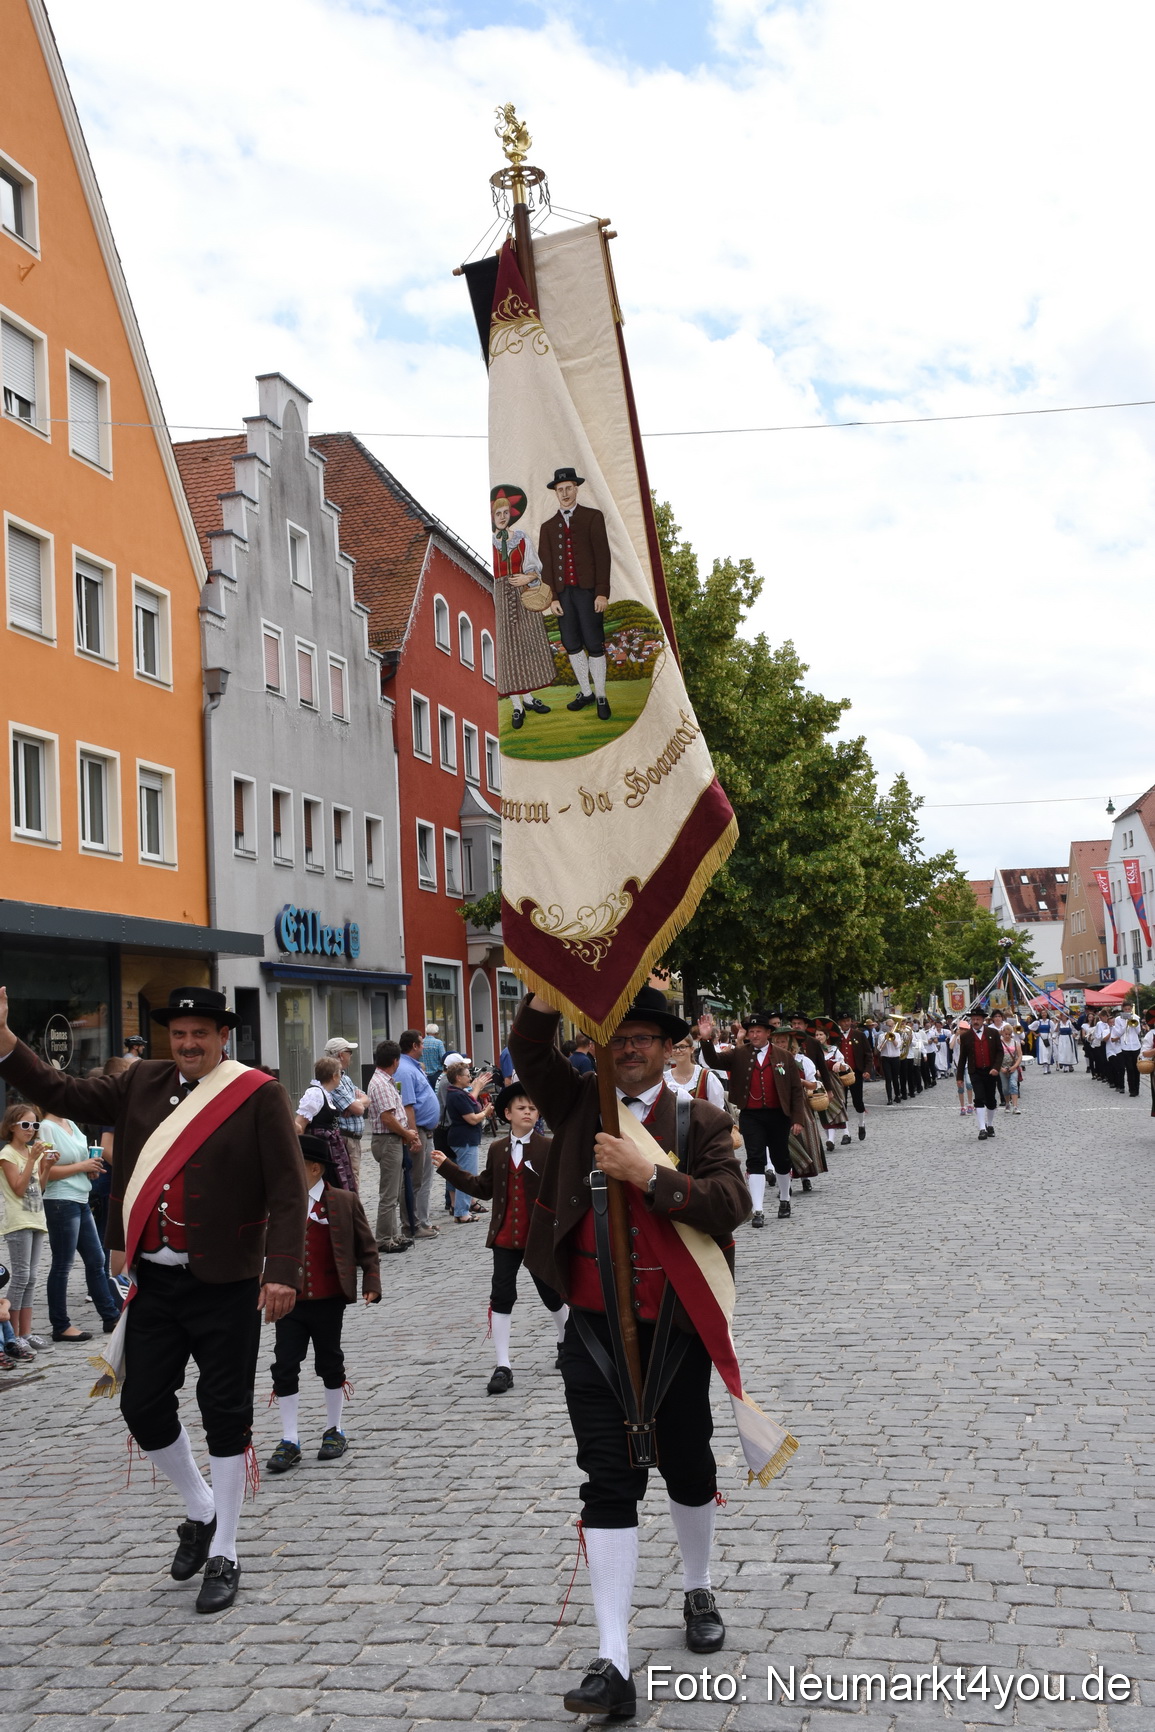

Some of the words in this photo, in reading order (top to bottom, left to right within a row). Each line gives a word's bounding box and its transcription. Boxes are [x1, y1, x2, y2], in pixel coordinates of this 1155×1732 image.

[578, 785, 613, 817] da
[278, 903, 345, 956] Eilles
[50, 1028, 68, 1040] Dianas
